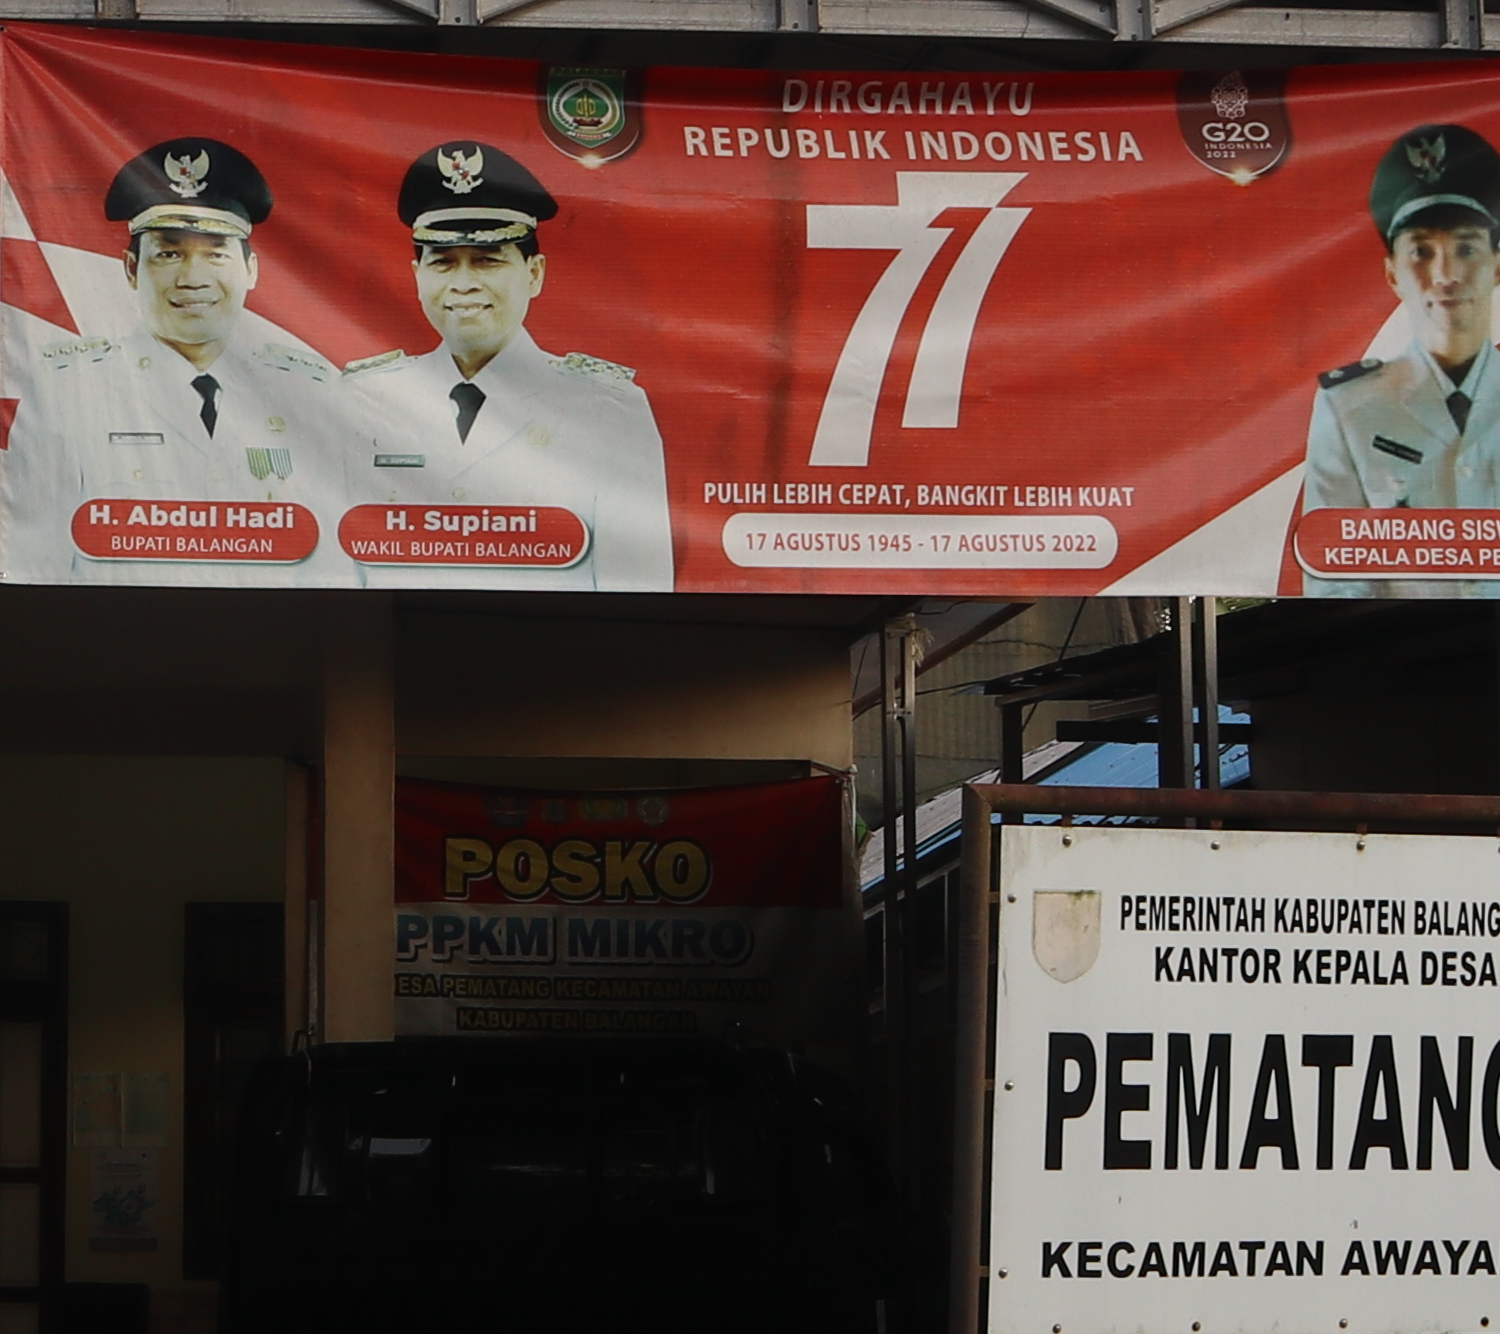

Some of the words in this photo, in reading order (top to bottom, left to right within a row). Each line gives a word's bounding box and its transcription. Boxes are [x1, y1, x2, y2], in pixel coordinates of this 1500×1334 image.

[782, 78, 1035, 116] DIRGAHAYU
[683, 126, 891, 160] REPUBLIK
[905, 131, 1144, 162] INDONESIA
[1202, 122, 1270, 142] G20
[806, 171, 1033, 467] 77
[704, 482, 766, 504] PULIH
[773, 483, 832, 505] LEBIH
[839, 484, 911, 509] CEPAT,
[918, 485, 1008, 506] BANGKIT
[1014, 486, 1072, 507] LEBIH
[1078, 487, 1134, 507] KUAT
[90, 505, 118, 527] H.
[129, 505, 217, 528] Abdul
[227, 506, 294, 529] Hadi
[386, 510, 414, 531] H.
[424, 508, 536, 536] Supiani
[1341, 520, 1455, 541] BAMBANG
[111, 535, 170, 552] BUPATI
[176, 536, 273, 553] BALANGAN
[352, 540, 405, 556] WAKIL
[411, 541, 469, 557] BUPATI
[475, 541, 571, 558] BALANGAN
[745, 533, 766, 551] 17
[773, 533, 861, 552] AGUSTUS
[867, 534, 912, 552] 1945
[930, 535, 951, 552] 17
[958, 534, 1045, 552] AGUSTUS
[1052, 535, 1096, 552] 2022
[1324, 547, 1409, 565] KEPALA
[1415, 548, 1473, 566] DESA
[445, 836, 710, 901] POSKO
[1120, 895, 1266, 933] PEMERINTAH
[1275, 898, 1405, 935] KABUPATEN
[396, 915, 554, 962] PPKM
[567, 916, 751, 963] MIKRO
[1155, 946, 1281, 984] KANTOR
[1293, 949, 1410, 985] KEPALA
[1420, 951, 1498, 987] DESA
[1041, 1240, 1325, 1278] KECAMATAN
